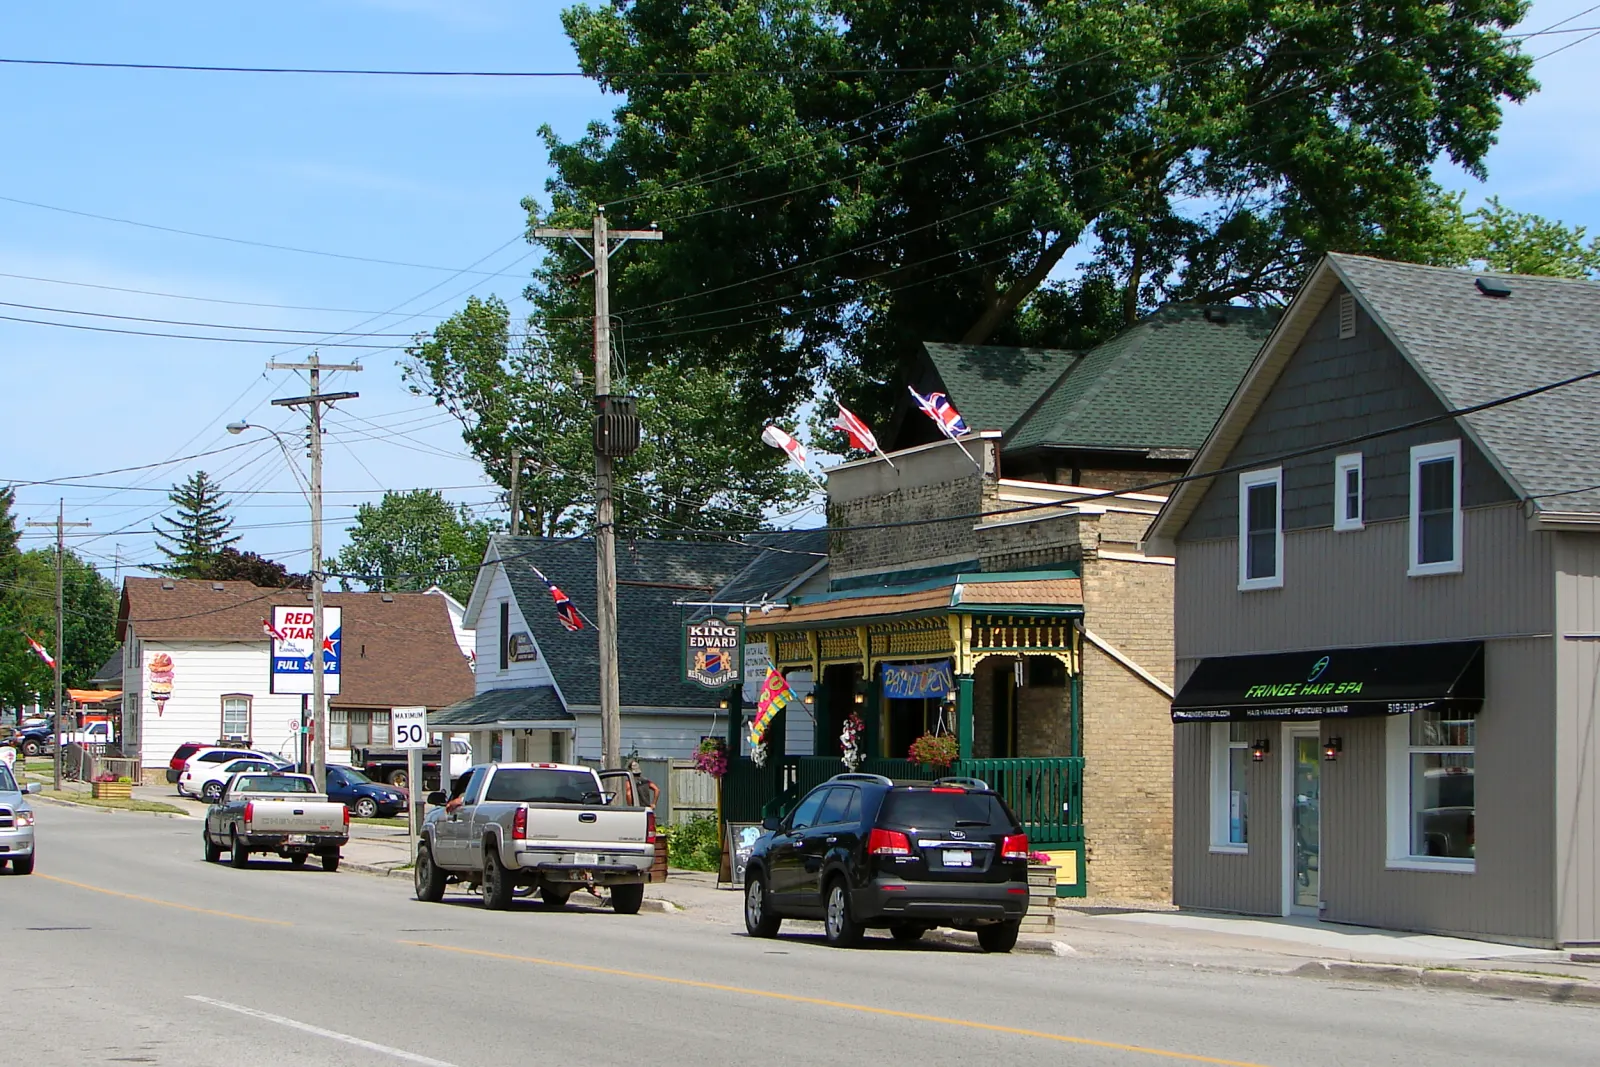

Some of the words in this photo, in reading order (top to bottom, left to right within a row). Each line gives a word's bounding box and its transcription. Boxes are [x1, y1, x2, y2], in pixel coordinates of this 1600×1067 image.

[284, 612, 314, 625] RED
[280, 627, 314, 640] STAR
[690, 627, 736, 636] KING
[690, 637, 736, 647] EDWARD
[277, 660, 299, 670] FULL
[687, 669, 722, 686] RESTAURANT
[727, 670, 738, 680] PUB
[920, 668, 953, 695] OPEN
[1245, 683, 1301, 698] FRINGE
[1299, 683, 1335, 695] HAIR
[1335, 682, 1363, 694] SPA
[397, 724, 422, 743] 50
[261, 817, 334, 826] CHEVROLET
